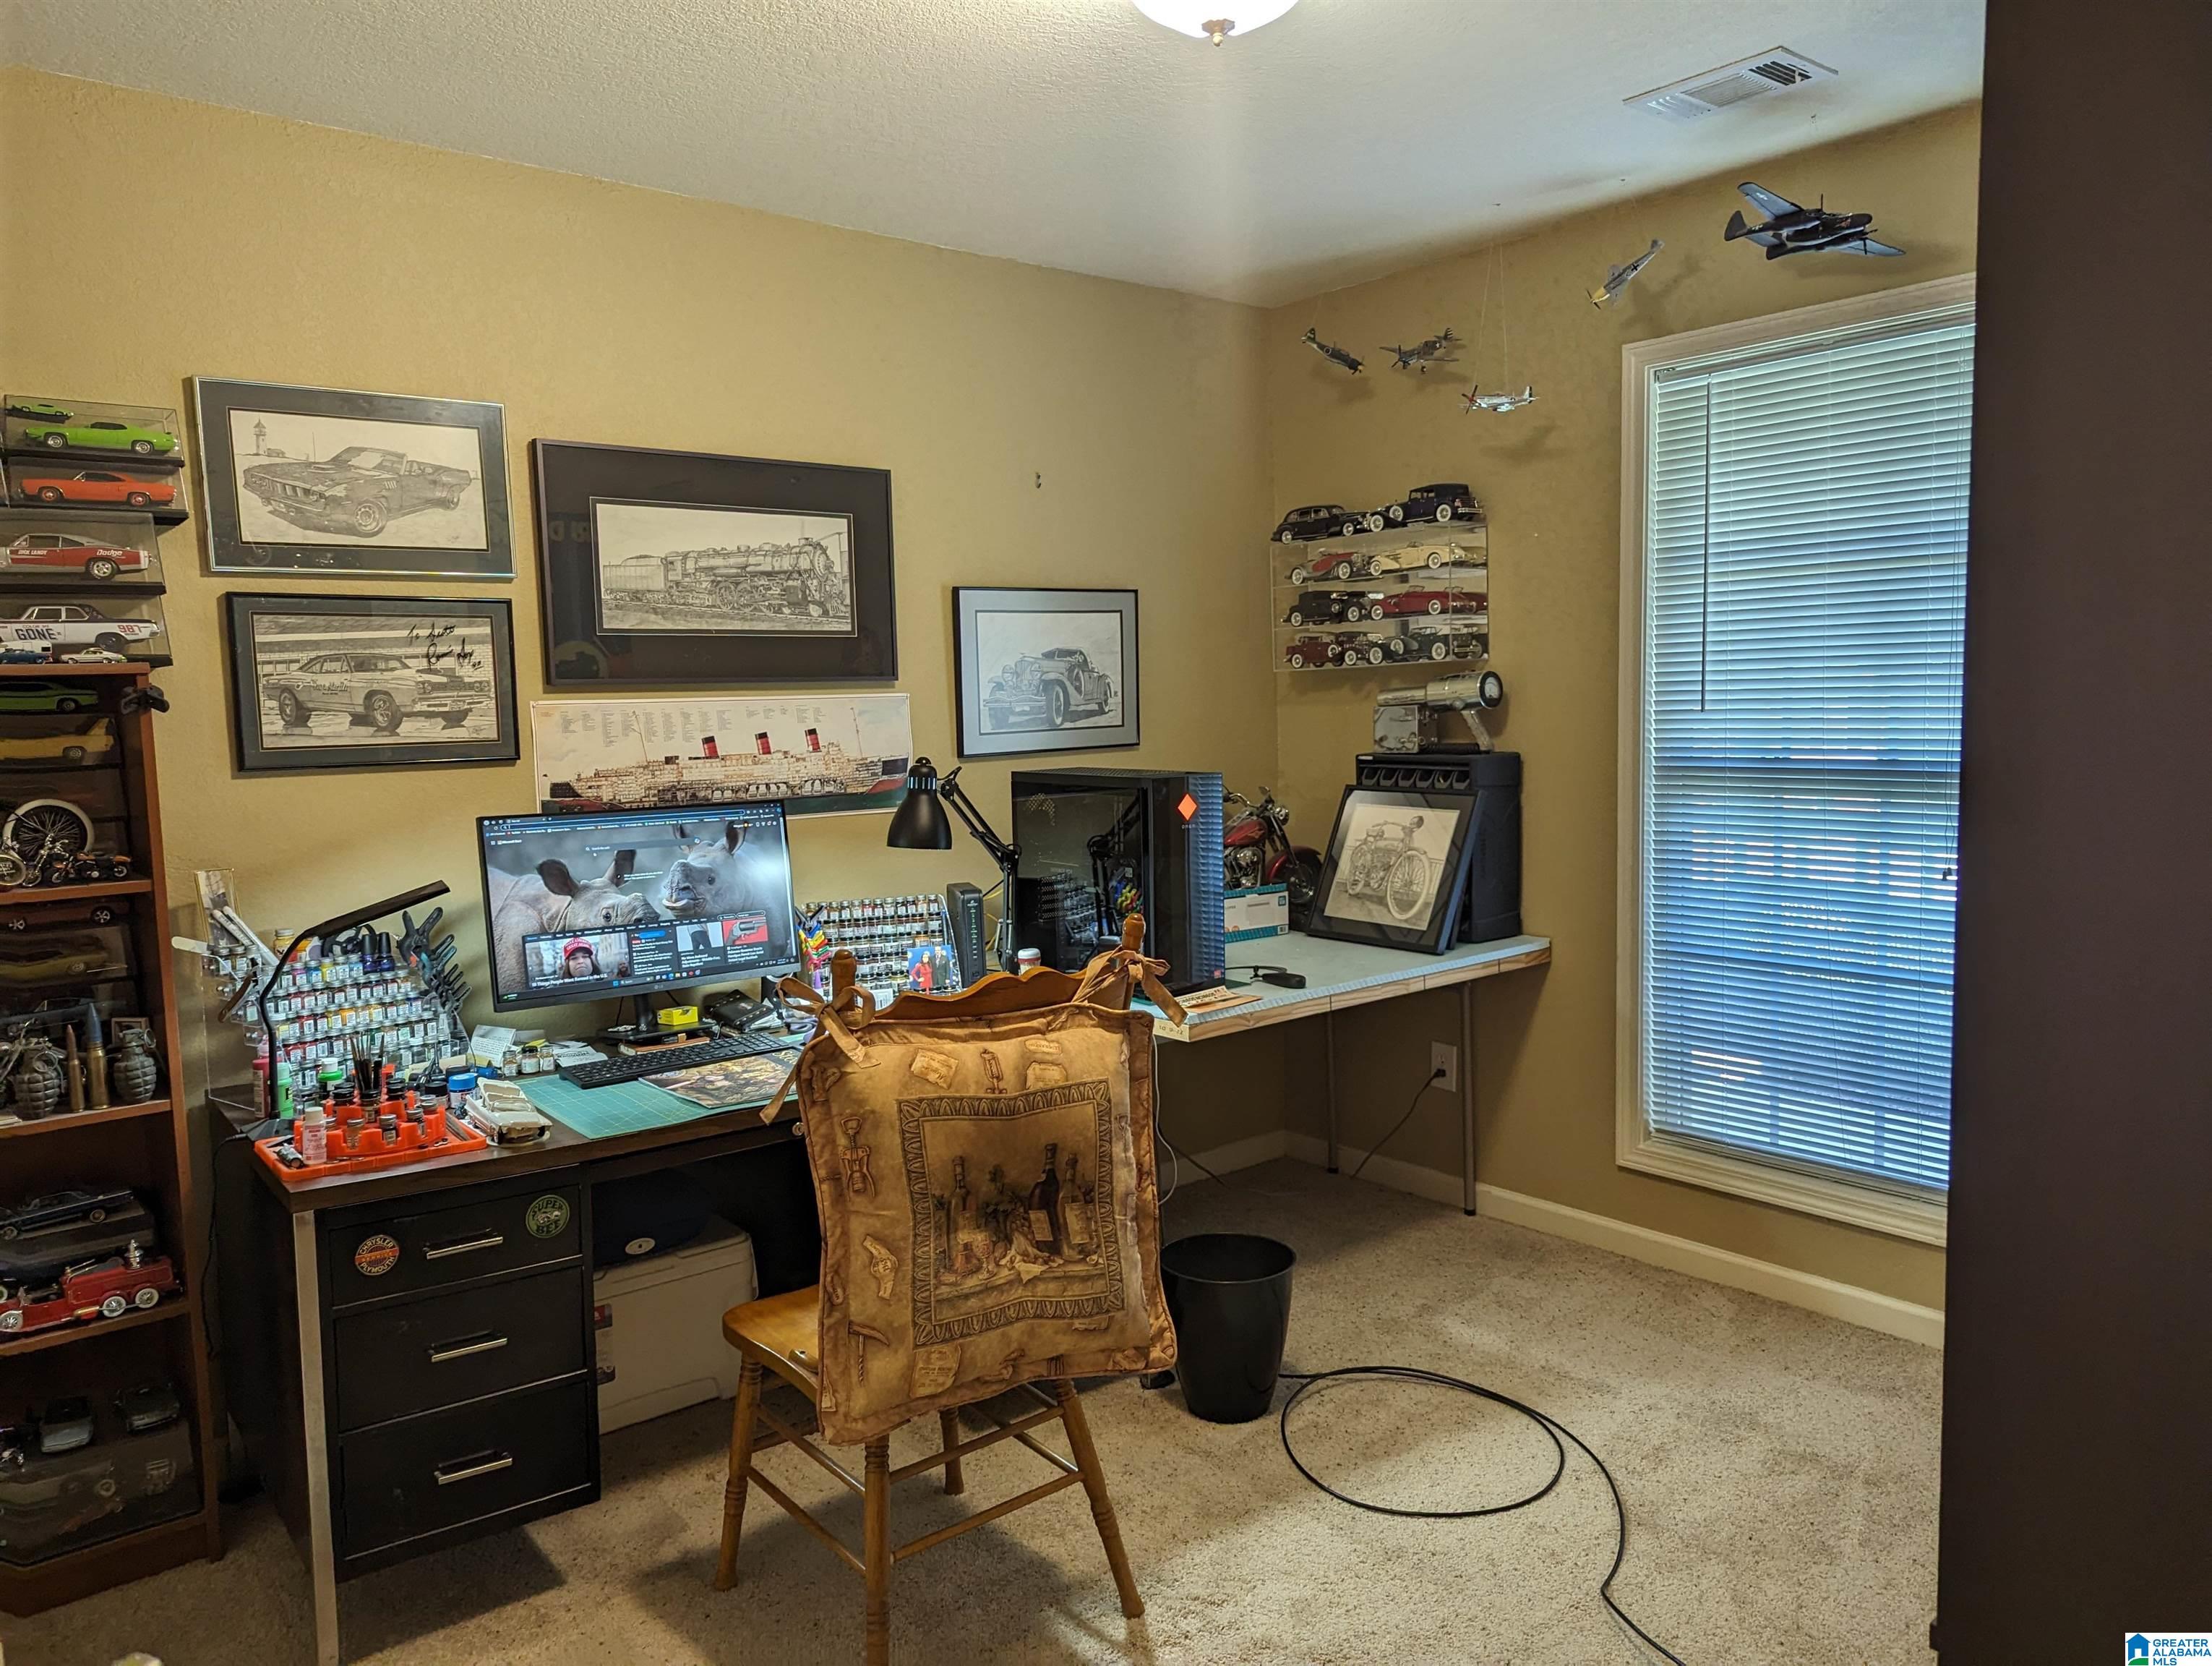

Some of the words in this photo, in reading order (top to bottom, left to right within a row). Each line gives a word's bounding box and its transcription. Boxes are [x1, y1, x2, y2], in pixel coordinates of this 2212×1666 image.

[15, 628, 57, 641] GONE
[117, 624, 141, 633] 987
[532, 1199, 564, 1221] SUPER
[536, 1219, 561, 1234] BEE
[360, 1237, 394, 1255] CHRYSLER
[359, 1257, 395, 1273] PLYMOUTH
